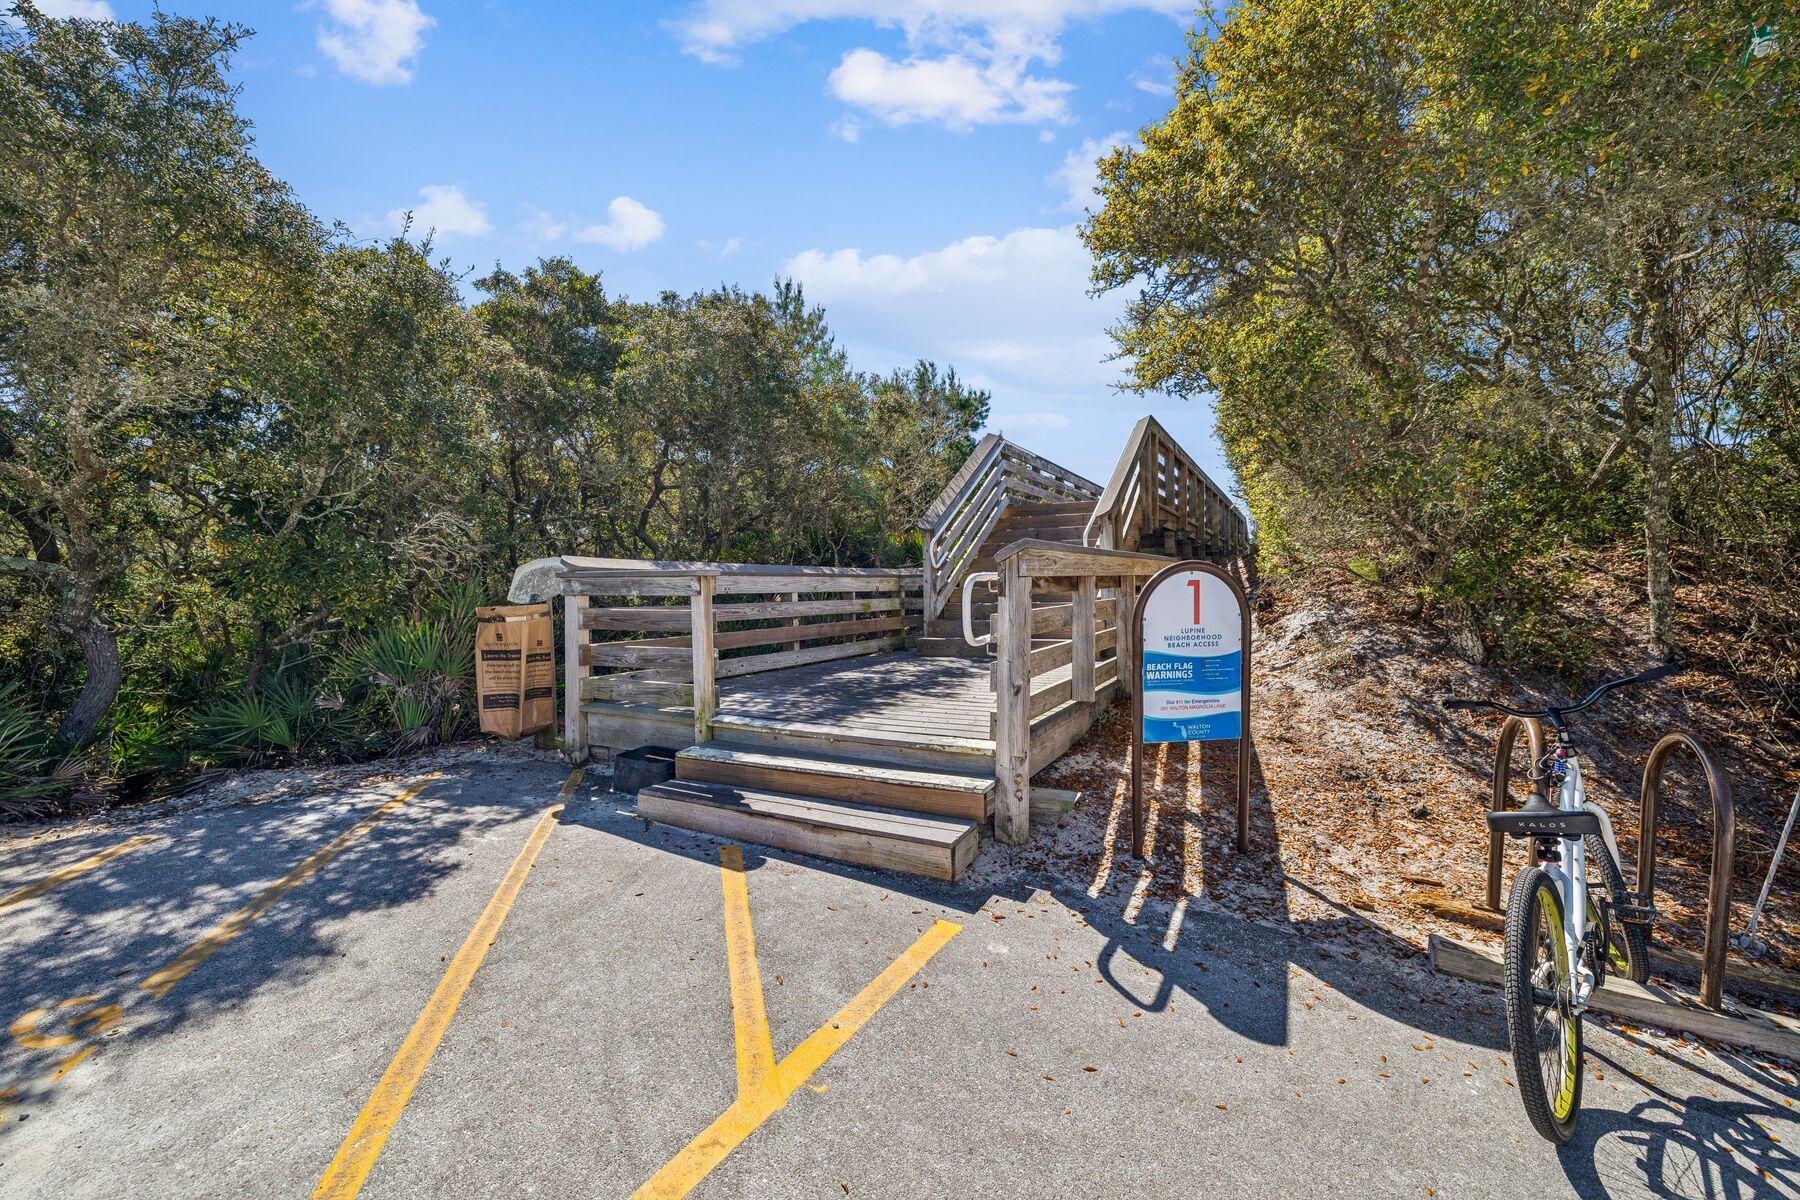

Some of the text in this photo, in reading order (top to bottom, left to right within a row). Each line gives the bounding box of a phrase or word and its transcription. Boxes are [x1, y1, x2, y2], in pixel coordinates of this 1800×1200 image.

[1187, 579, 1200, 625] 1
[1163, 634, 1223, 642] NEIGHBORHOOD
[1193, 640, 1220, 648] ACCESS
[1146, 662, 1193, 671] BEACH FLAG
[1146, 670, 1193, 679] WARNINGS
